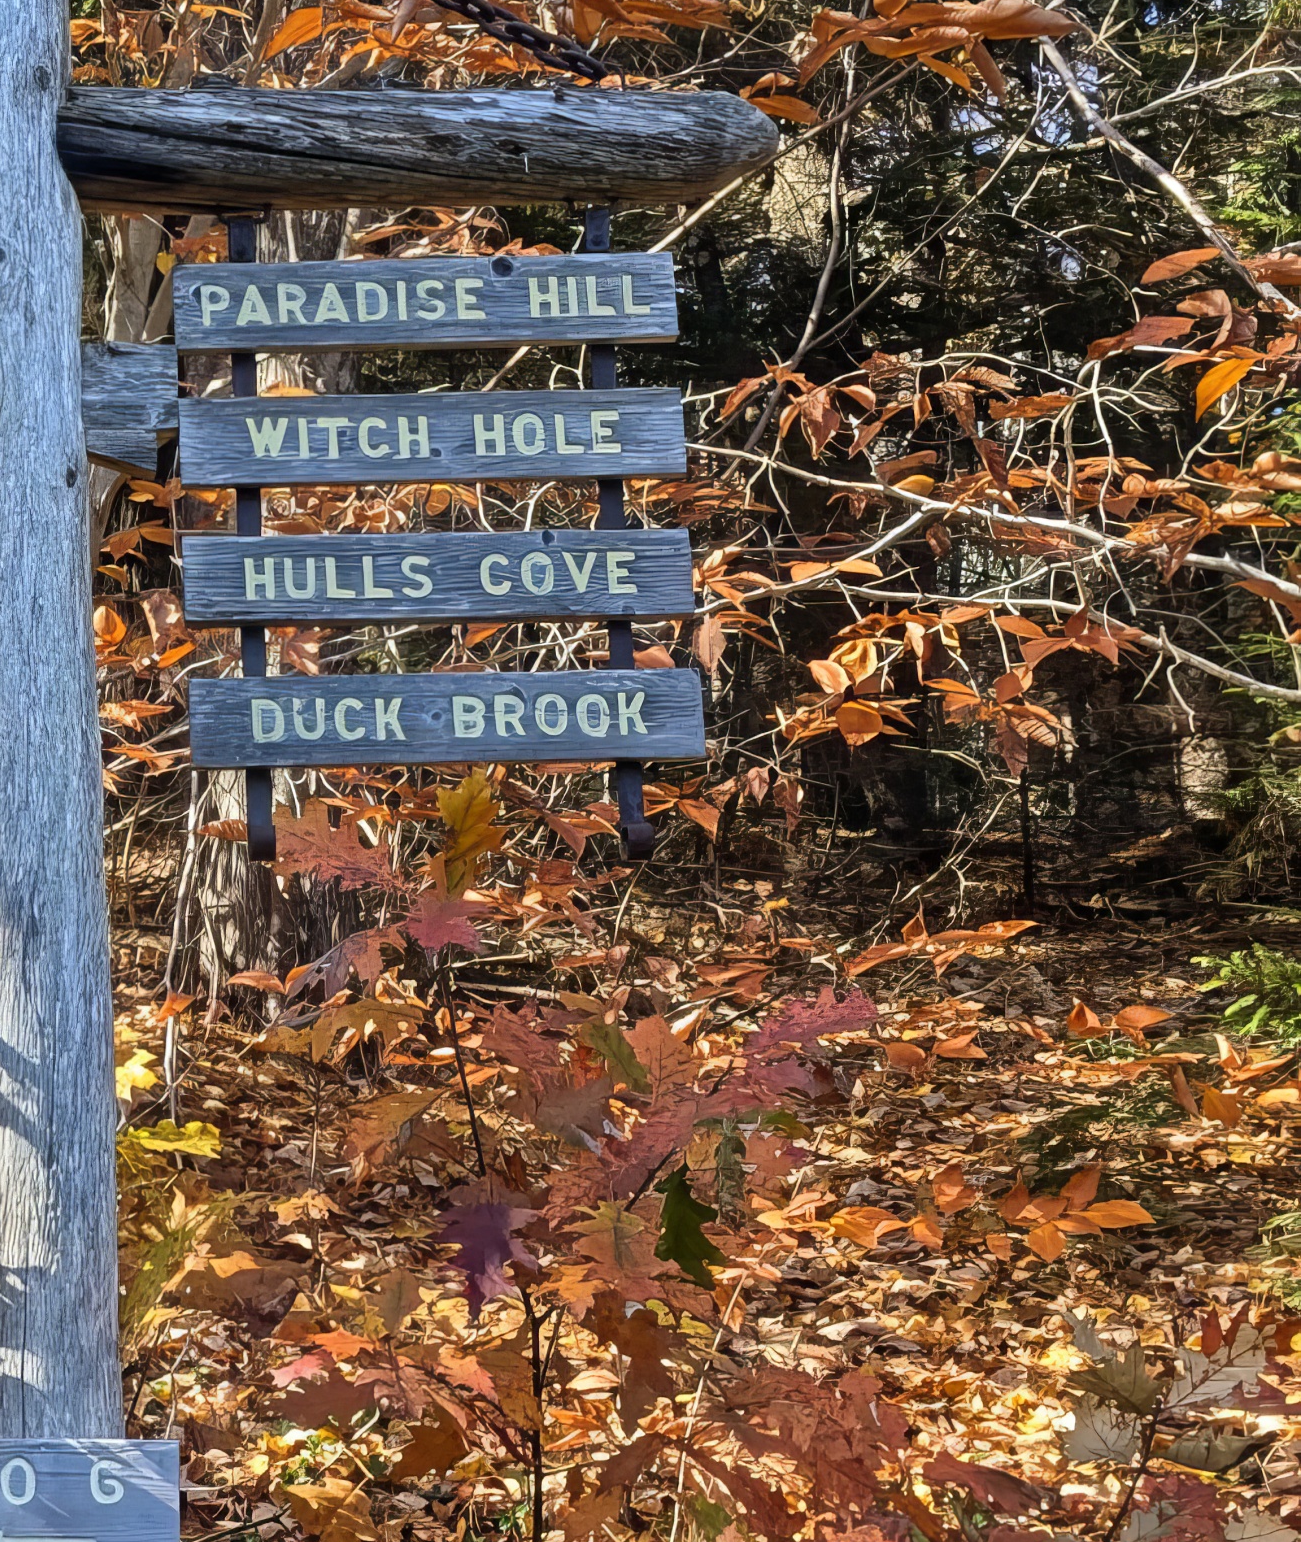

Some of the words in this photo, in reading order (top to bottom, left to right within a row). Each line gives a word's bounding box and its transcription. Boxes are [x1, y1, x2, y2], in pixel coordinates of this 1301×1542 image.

[201, 277, 487, 327] PARADISE
[528, 274, 651, 318] HILL
[245, 415, 431, 459] WITCH
[473, 409, 622, 456] HOLE
[243, 554, 434, 601] HULLS
[479, 550, 637, 596] COVE
[250, 695, 407, 743] DUCK
[452, 691, 649, 738] BROOK
[90, 1459, 125, 1505] 6
